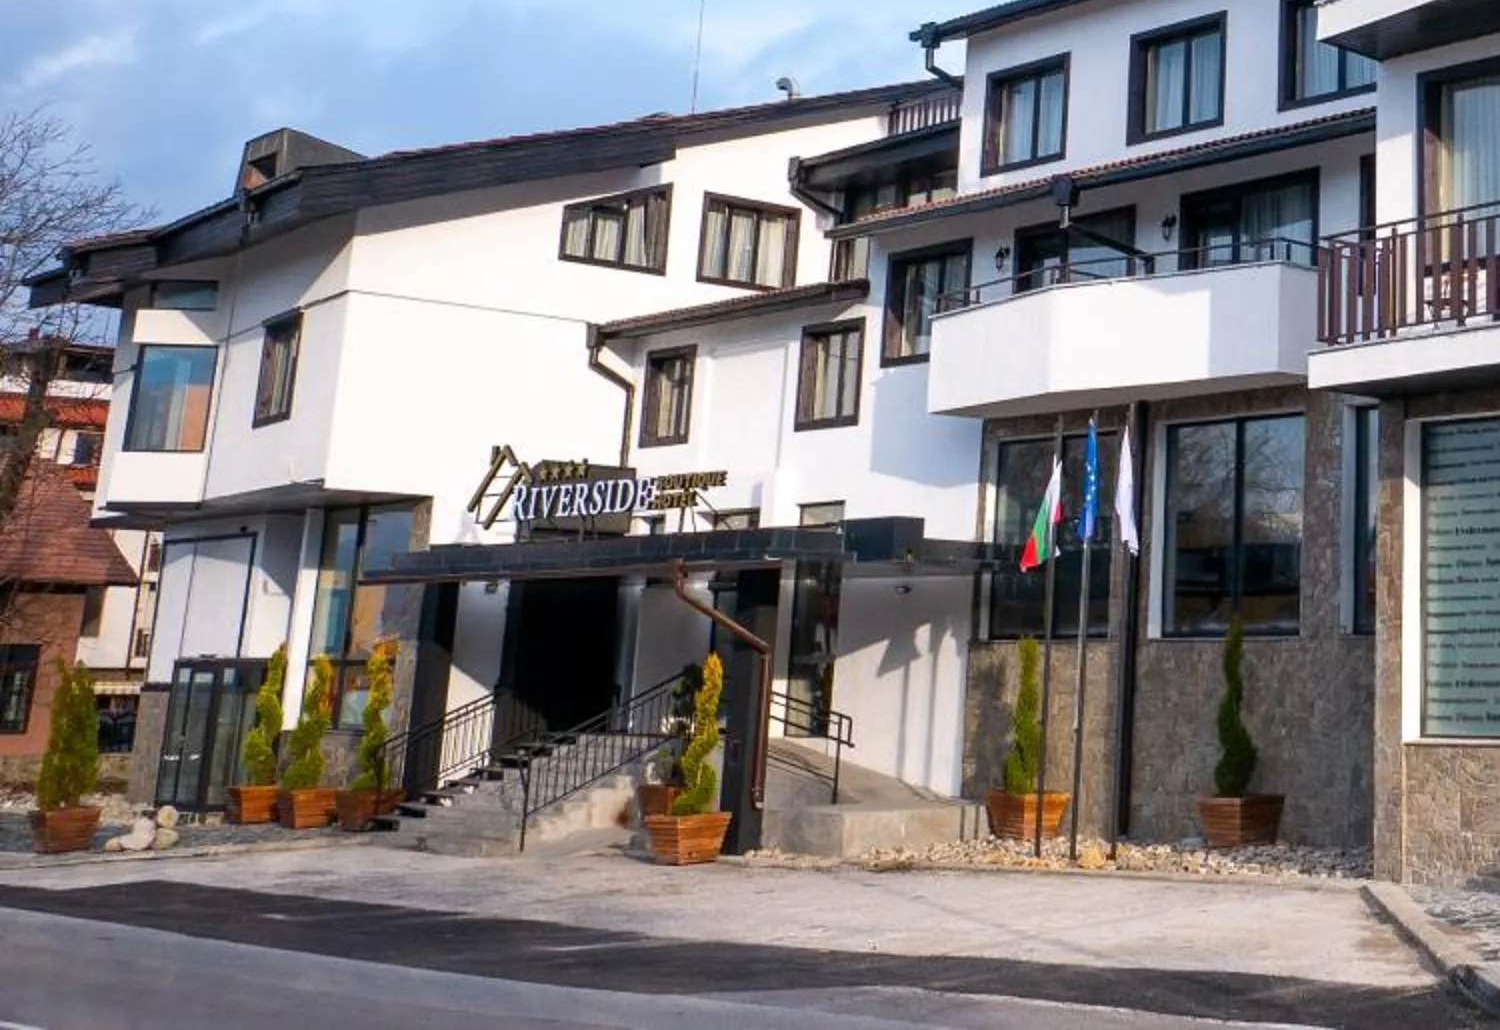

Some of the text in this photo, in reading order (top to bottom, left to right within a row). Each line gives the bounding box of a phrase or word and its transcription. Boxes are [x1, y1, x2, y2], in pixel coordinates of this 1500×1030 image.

[652, 470, 728, 491] BOUTIQUE
[511, 476, 652, 520] RIVERSIDE
[647, 491, 699, 510] HOTEL
